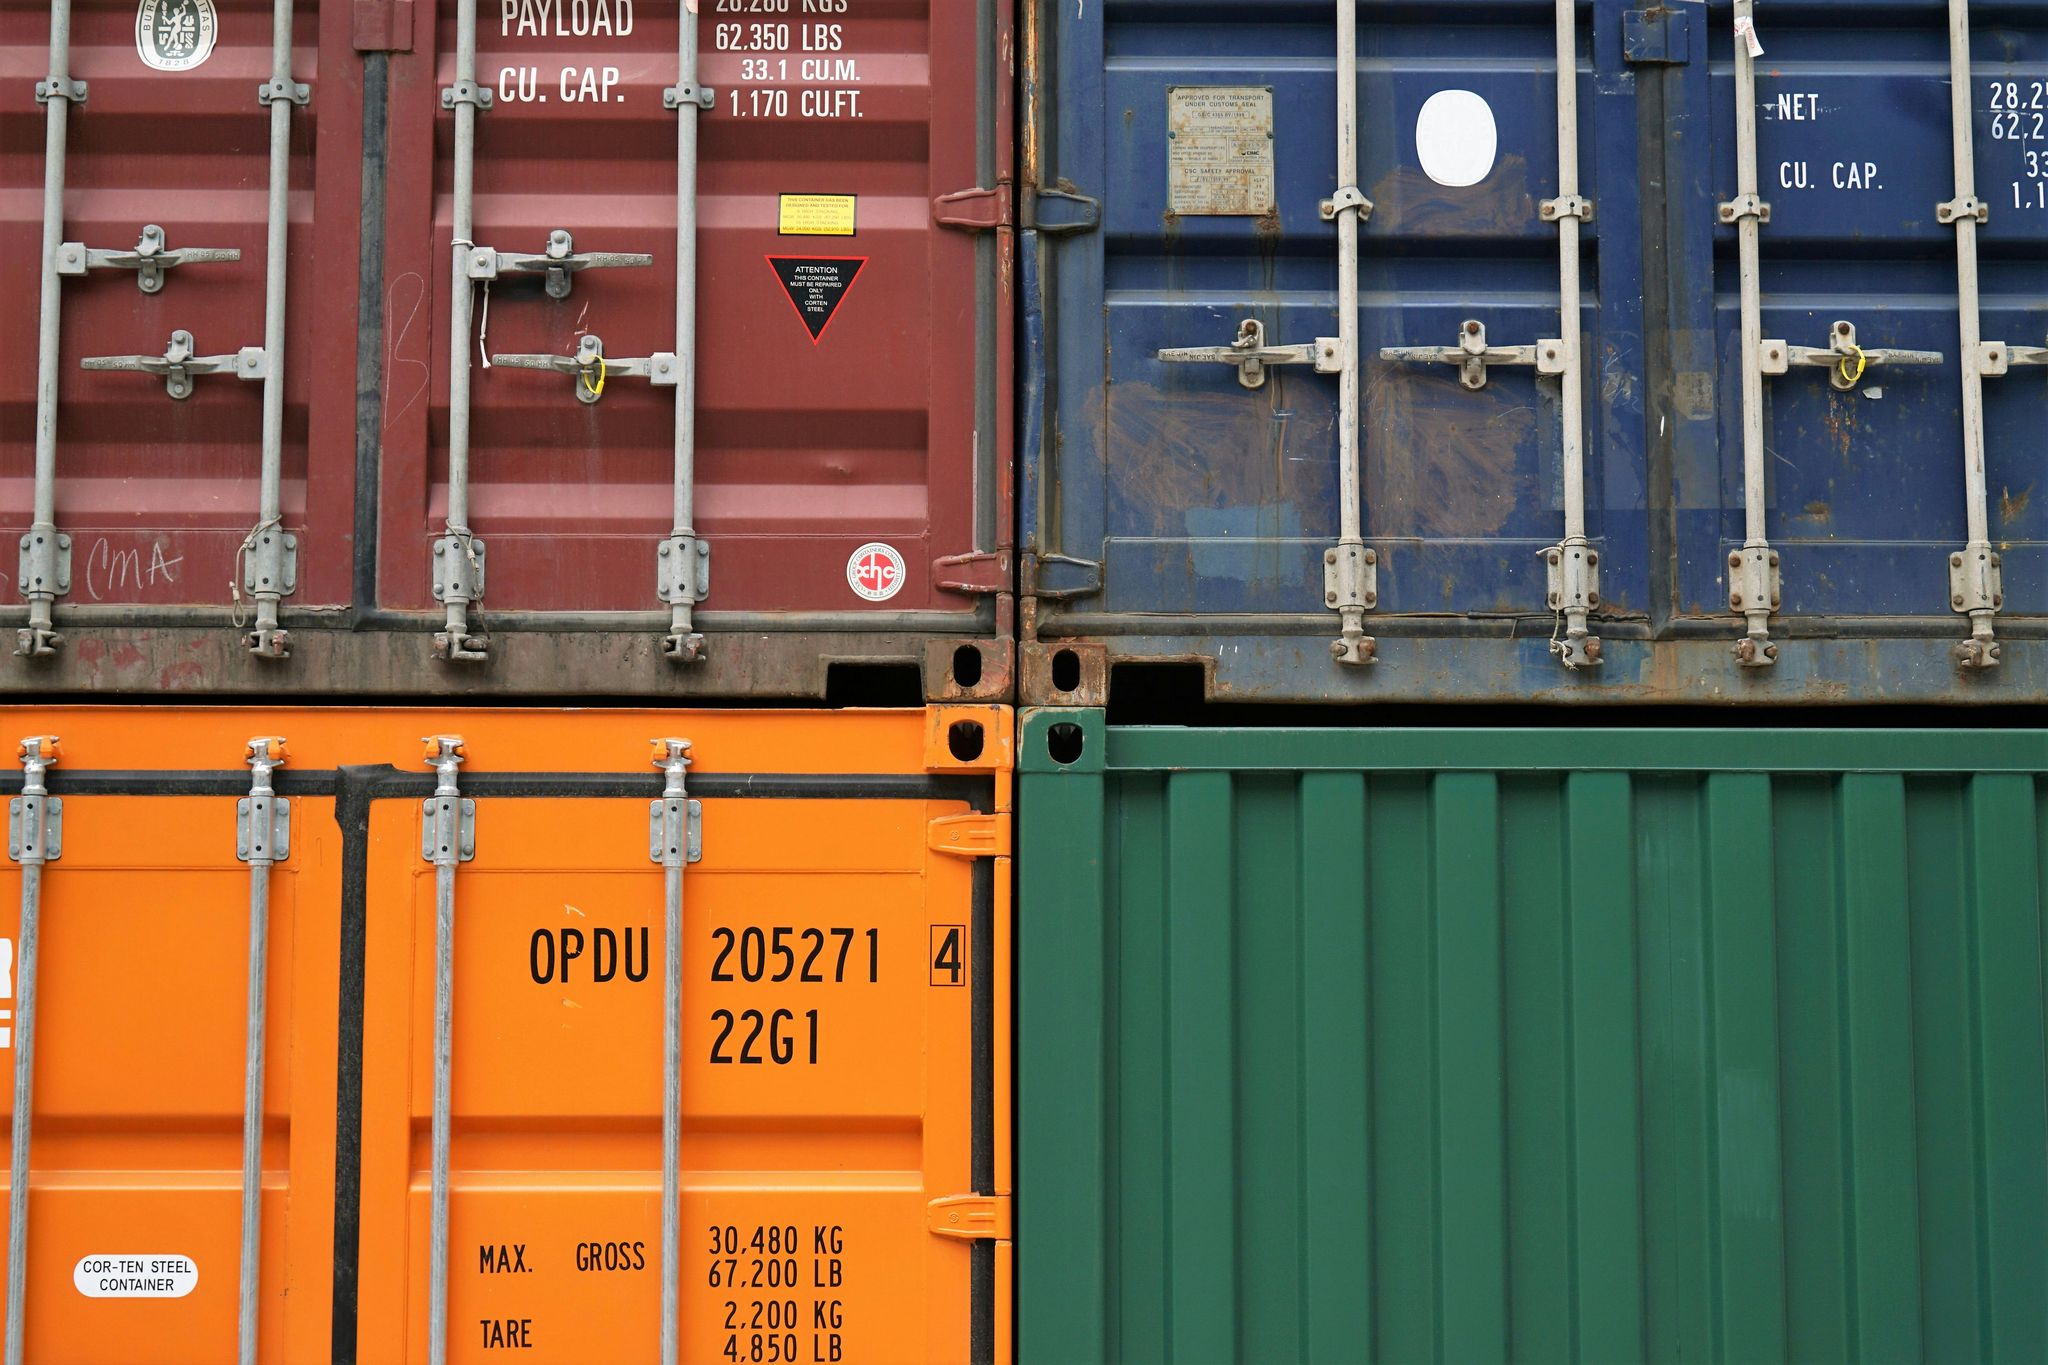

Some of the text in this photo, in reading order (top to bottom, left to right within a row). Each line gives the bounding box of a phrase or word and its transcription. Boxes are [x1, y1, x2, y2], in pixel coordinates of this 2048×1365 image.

[500, 0, 634, 37] PAYLOAD
[715, 23, 842, 51] 62,350 LBS
[499, 66, 625, 103] CU. CAP.
[741, 59, 861, 81] 33.1 CU.M.
[730, 89, 863, 117] 1,170 CU.FT.
[1778, 93, 1819, 121] NET
[1780, 162, 1883, 190] CU. CAP.
[795, 266, 838, 274] ATTENTION
[86, 534, 185, 601] CMA
[529, 926, 962, 985] OPDU 205271 4
[709, 1008, 819, 1066] 22G1
[708, 1225, 843, 1255] 30,480 KG
[83, 1260, 191, 1273] COR-TEN STEEL
[479, 1241, 646, 1274] MAX. GROSS
[99, 1278, 174, 1292] CONTAINER
[708, 1258, 842, 1288] 67,200 LB
[724, 1300, 843, 1330] 2,200 KG
[480, 1318, 533, 1349] TARE
[723, 1333, 842, 1363] 4,850 LB
